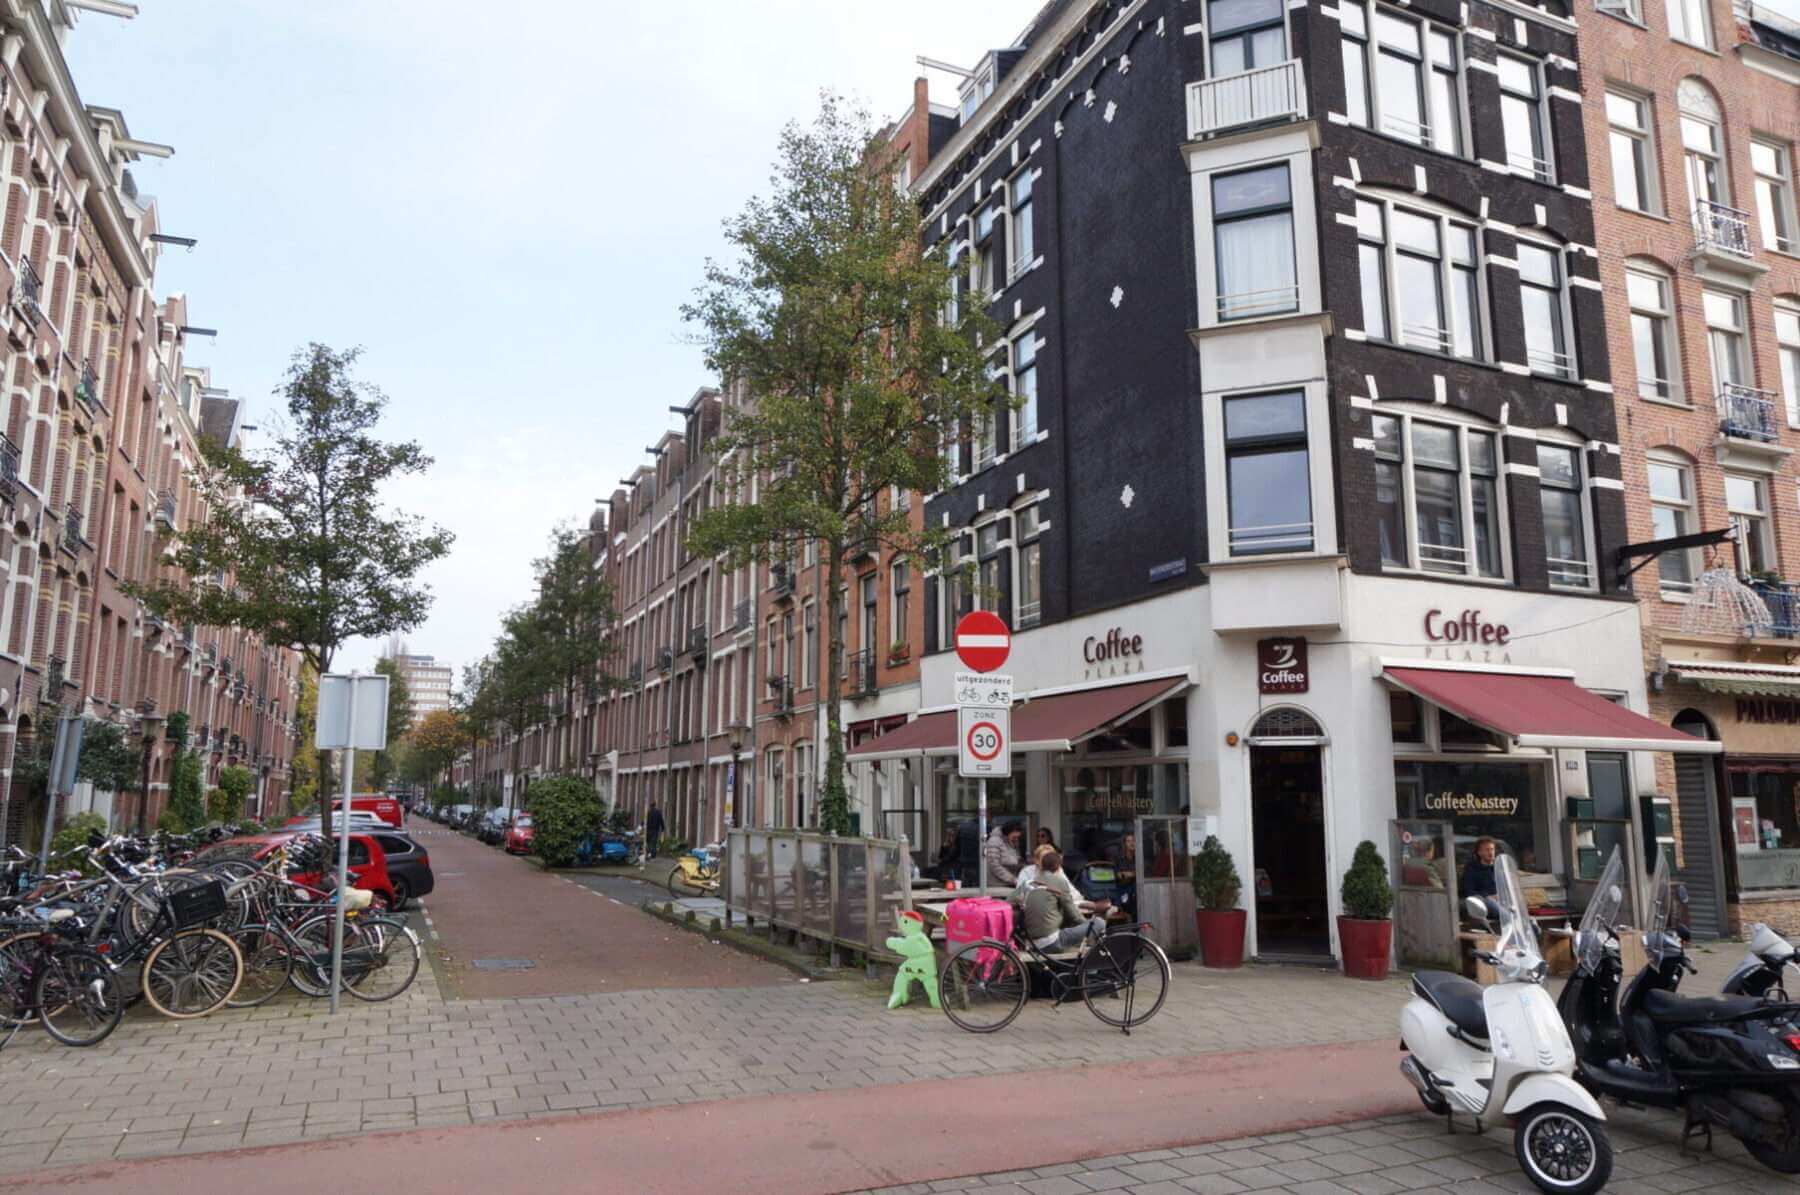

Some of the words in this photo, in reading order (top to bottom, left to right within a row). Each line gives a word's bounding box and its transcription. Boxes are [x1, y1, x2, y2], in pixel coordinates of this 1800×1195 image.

[1424, 609, 1510, 645] Coffee
[1083, 627, 1142, 663] Coffee
[1425, 647, 1511, 663] PLAZA
[1085, 661, 1144, 679] PLAZA
[1262, 670, 1304, 683] Coffee
[957, 675, 1011, 686] uitgezonderd
[973, 711, 996, 719] ZONE
[974, 733, 996, 749] 30
